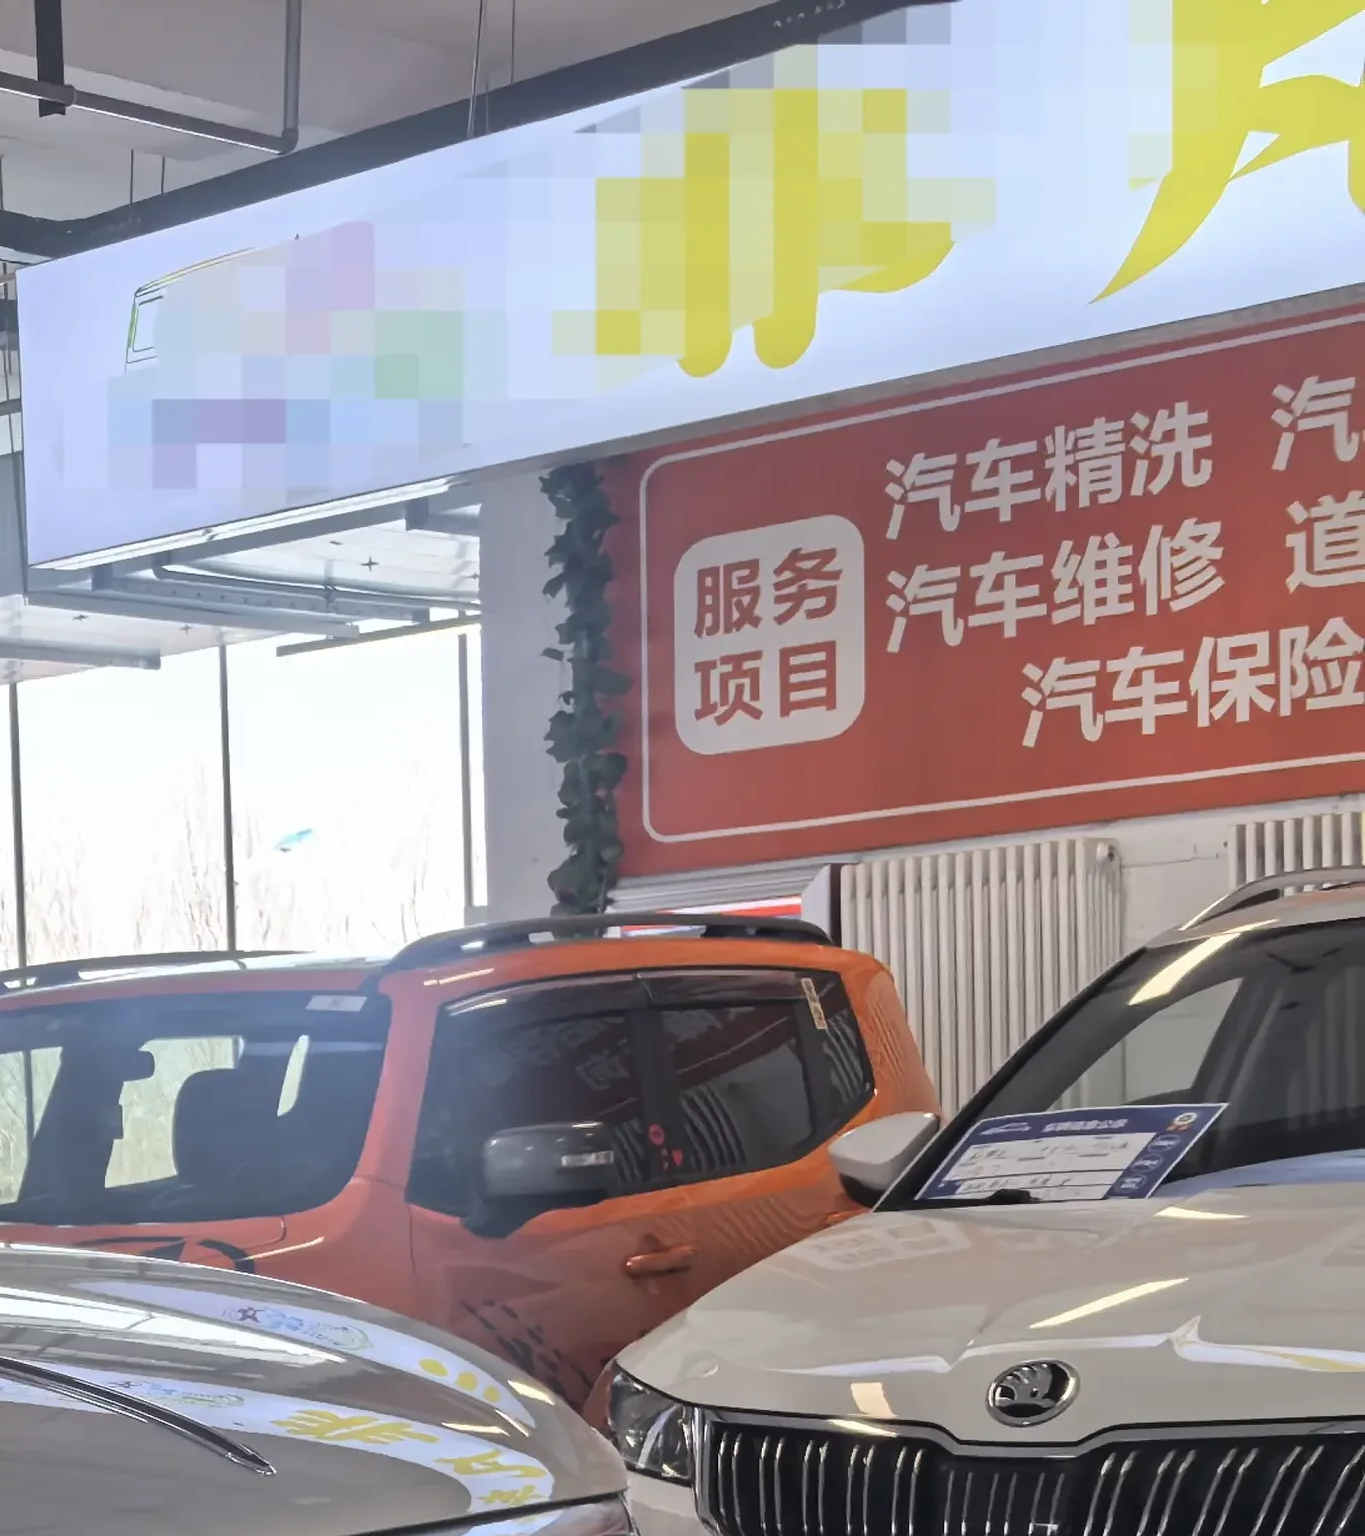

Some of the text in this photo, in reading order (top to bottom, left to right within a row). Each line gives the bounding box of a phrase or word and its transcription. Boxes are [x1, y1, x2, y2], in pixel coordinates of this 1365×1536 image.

[885, 375, 1365, 540] 汽车精洗 汽
[693, 547, 843, 639] 服务
[886, 490, 1365, 653] 汽车维修 道
[693, 640, 838, 726] 项目
[1021, 615, 1365, 748] 汽车保险
